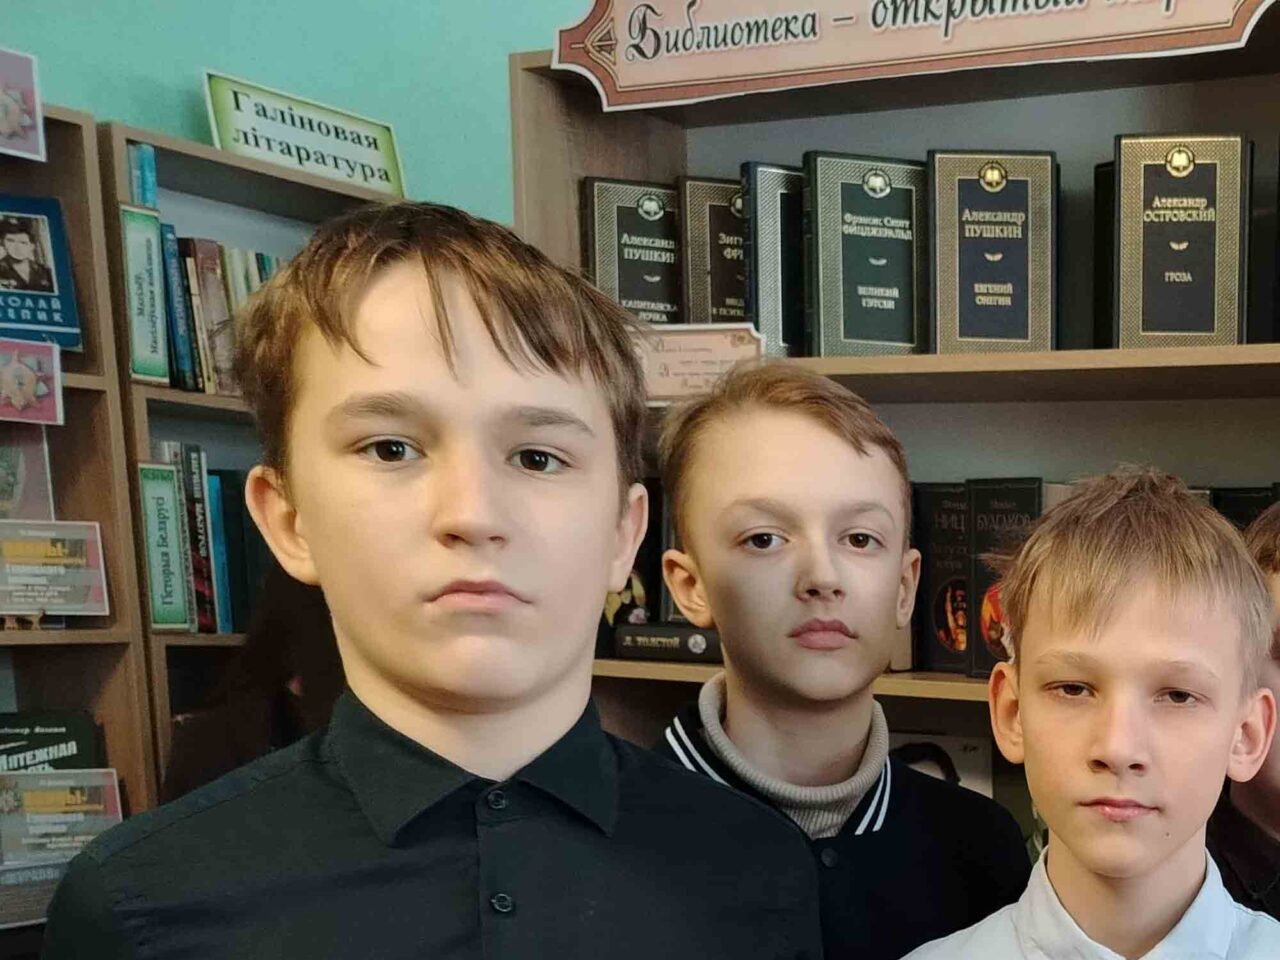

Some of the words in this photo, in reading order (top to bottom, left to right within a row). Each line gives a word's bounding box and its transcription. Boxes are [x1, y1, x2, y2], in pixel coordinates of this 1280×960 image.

[625, 0, 818, 60] Библиотека
[231, 90, 380, 150] Галіновая
[233, 127, 391, 183] літаратура
[1152, 196, 1207, 209] Александр
[962, 208, 1025, 224] Александр
[1143, 208, 1215, 223] ОСТРОВСКИЙ
[964, 224, 1022, 239] ПУШКИН
[620, 233, 674, 249] Александ
[1165, 271, 1192, 283] ГРОЗА
[0, 309, 63, 323] ЕПИК
[152, 496, 169, 548] Беларусі
[159, 551, 175, 606] Гісторыя
